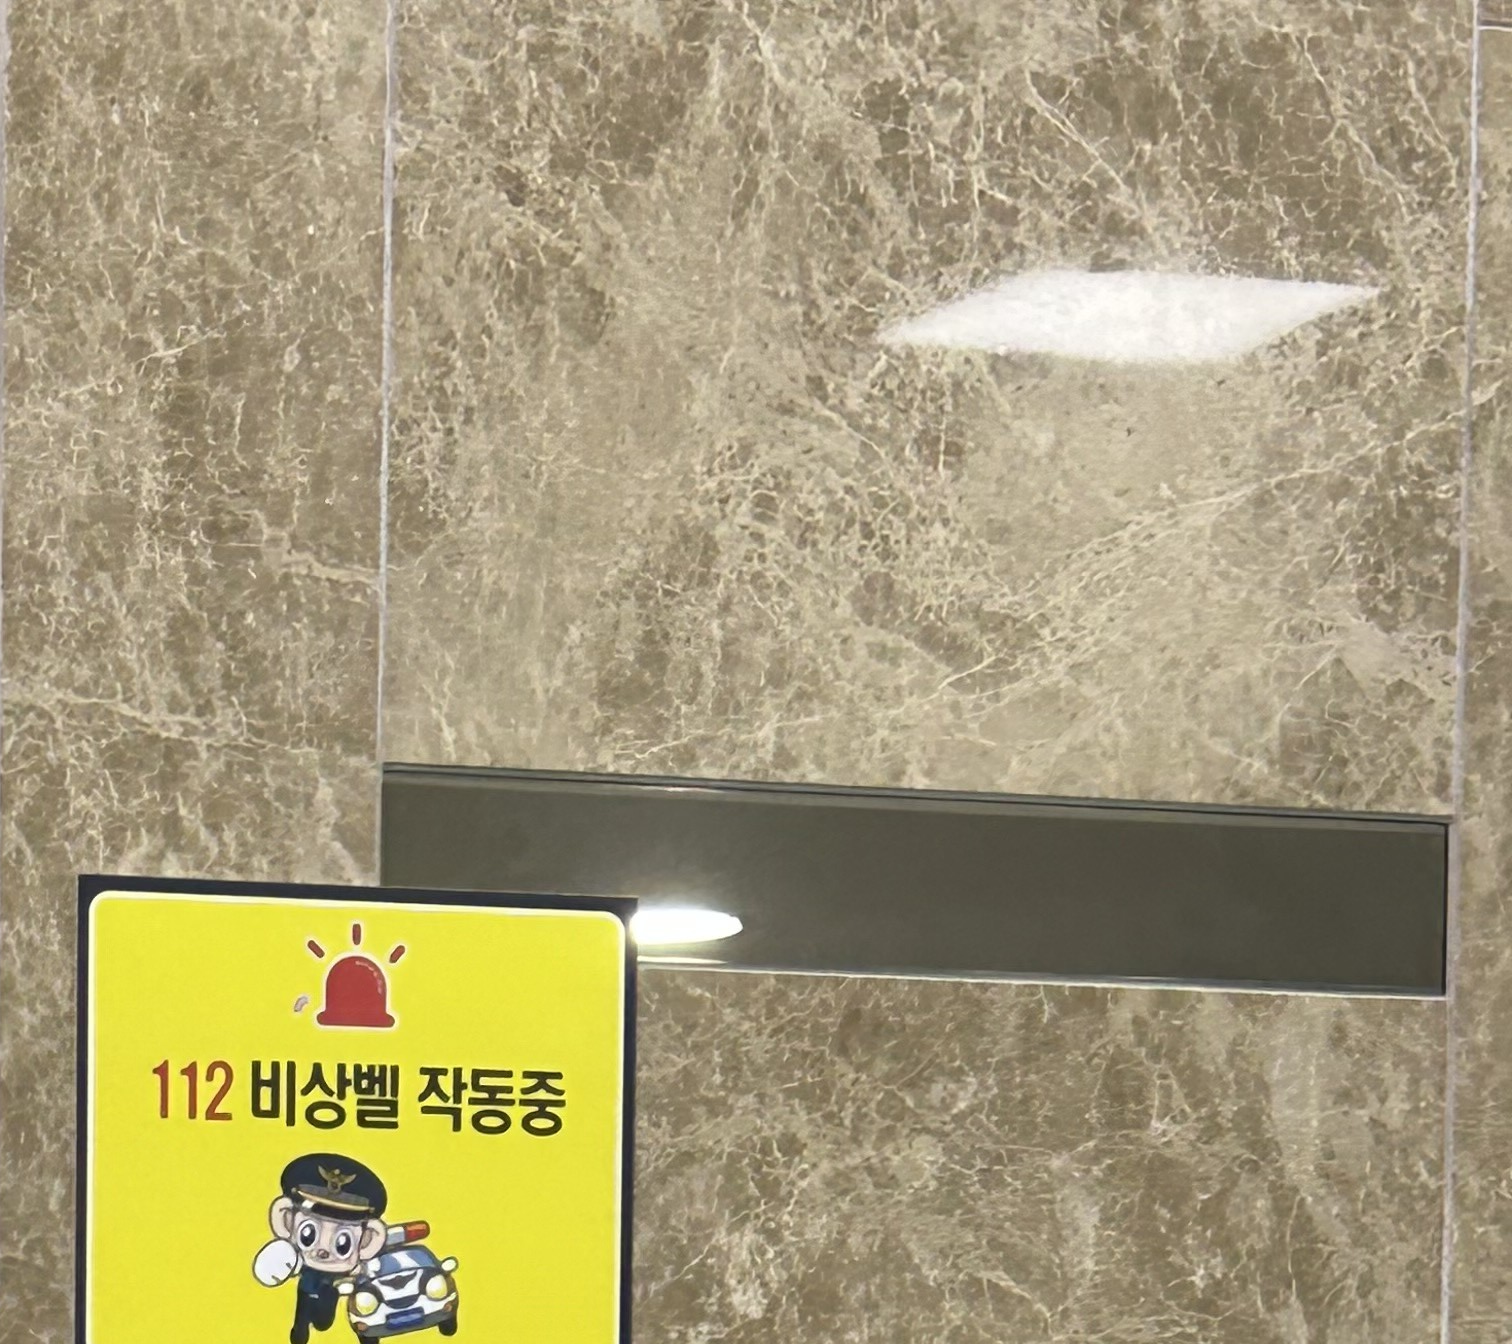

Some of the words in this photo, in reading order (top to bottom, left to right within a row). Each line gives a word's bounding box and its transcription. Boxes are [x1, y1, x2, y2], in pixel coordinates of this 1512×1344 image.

[152, 1059, 234, 1121] 112
[251, 1060, 399, 1130] 비상벨
[418, 1066, 566, 1137] 작동중
